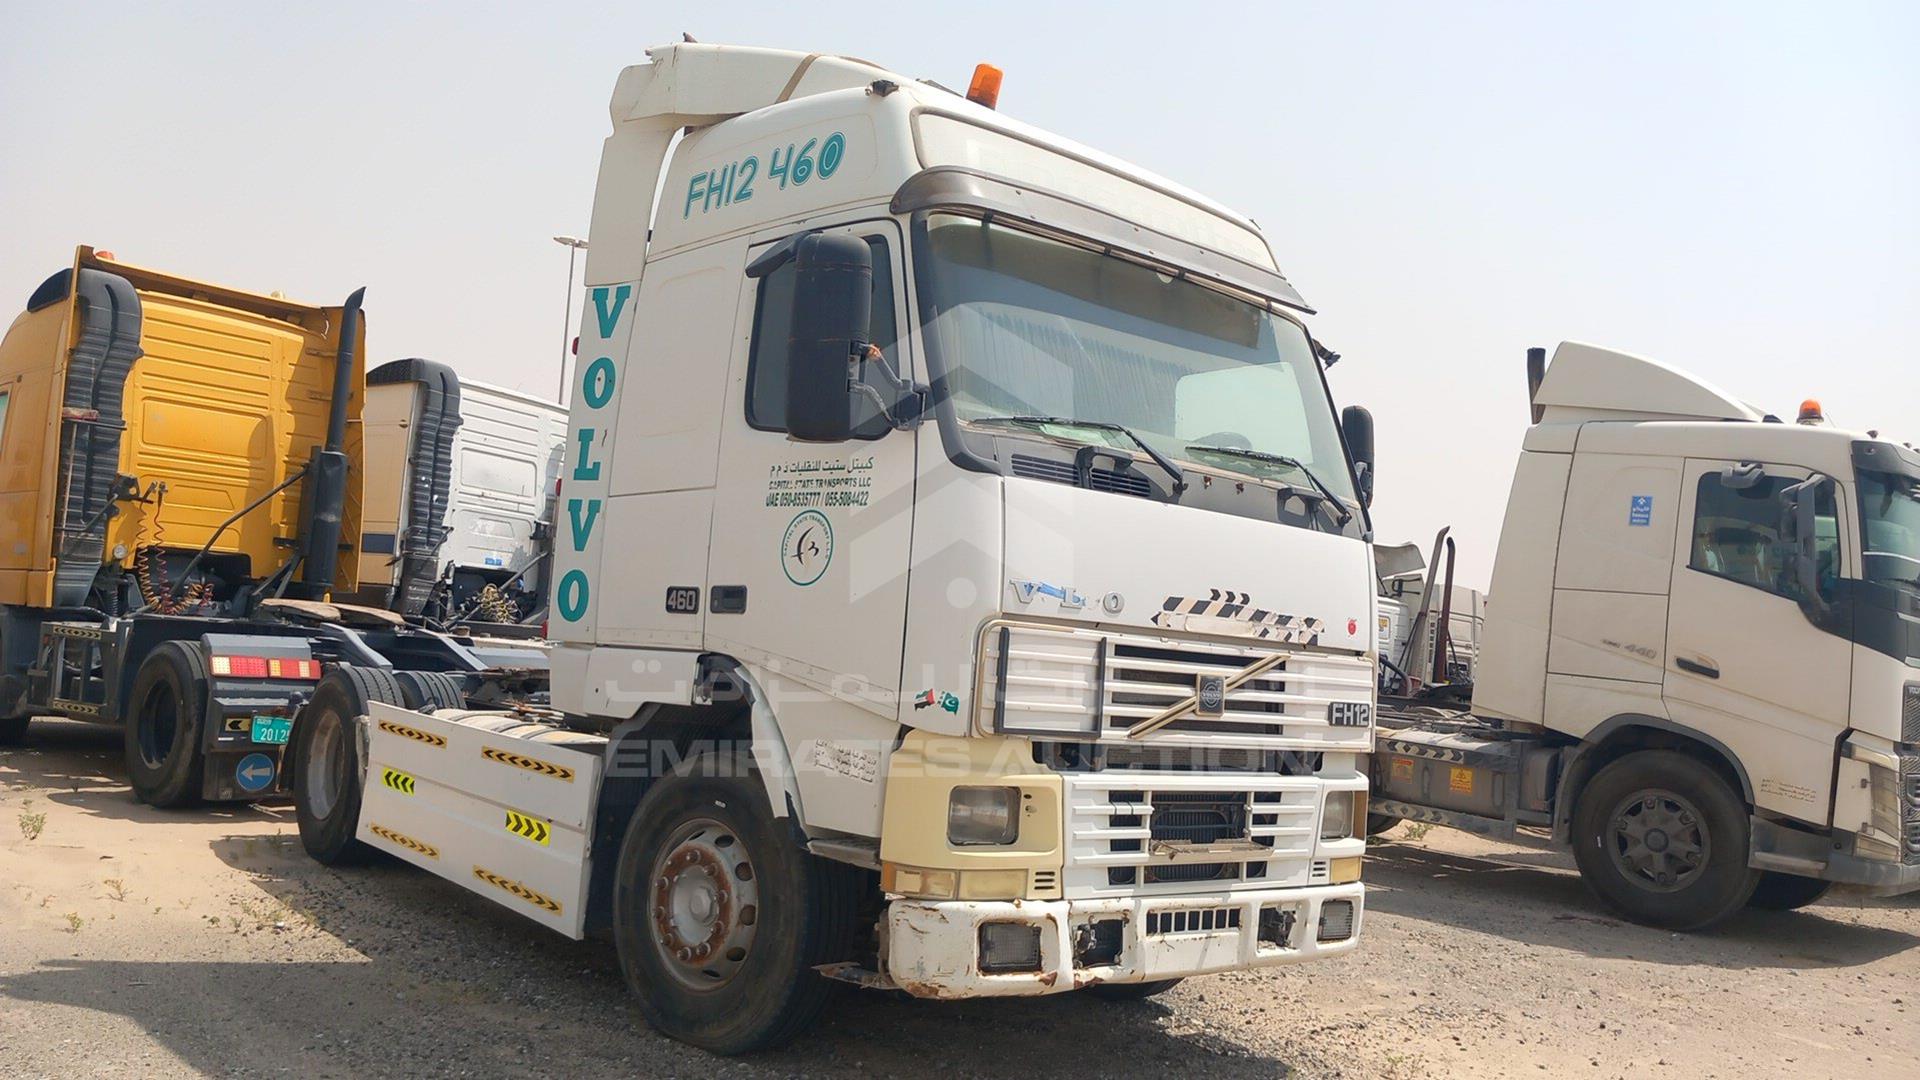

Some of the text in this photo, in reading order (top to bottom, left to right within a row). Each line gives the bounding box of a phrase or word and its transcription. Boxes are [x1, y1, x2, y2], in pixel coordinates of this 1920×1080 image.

[683, 131, 847, 220] FH12 460
[557, 285, 632, 622] VOLVO
[667, 589, 696, 610] 460
[1332, 703, 1369, 725] FH12
